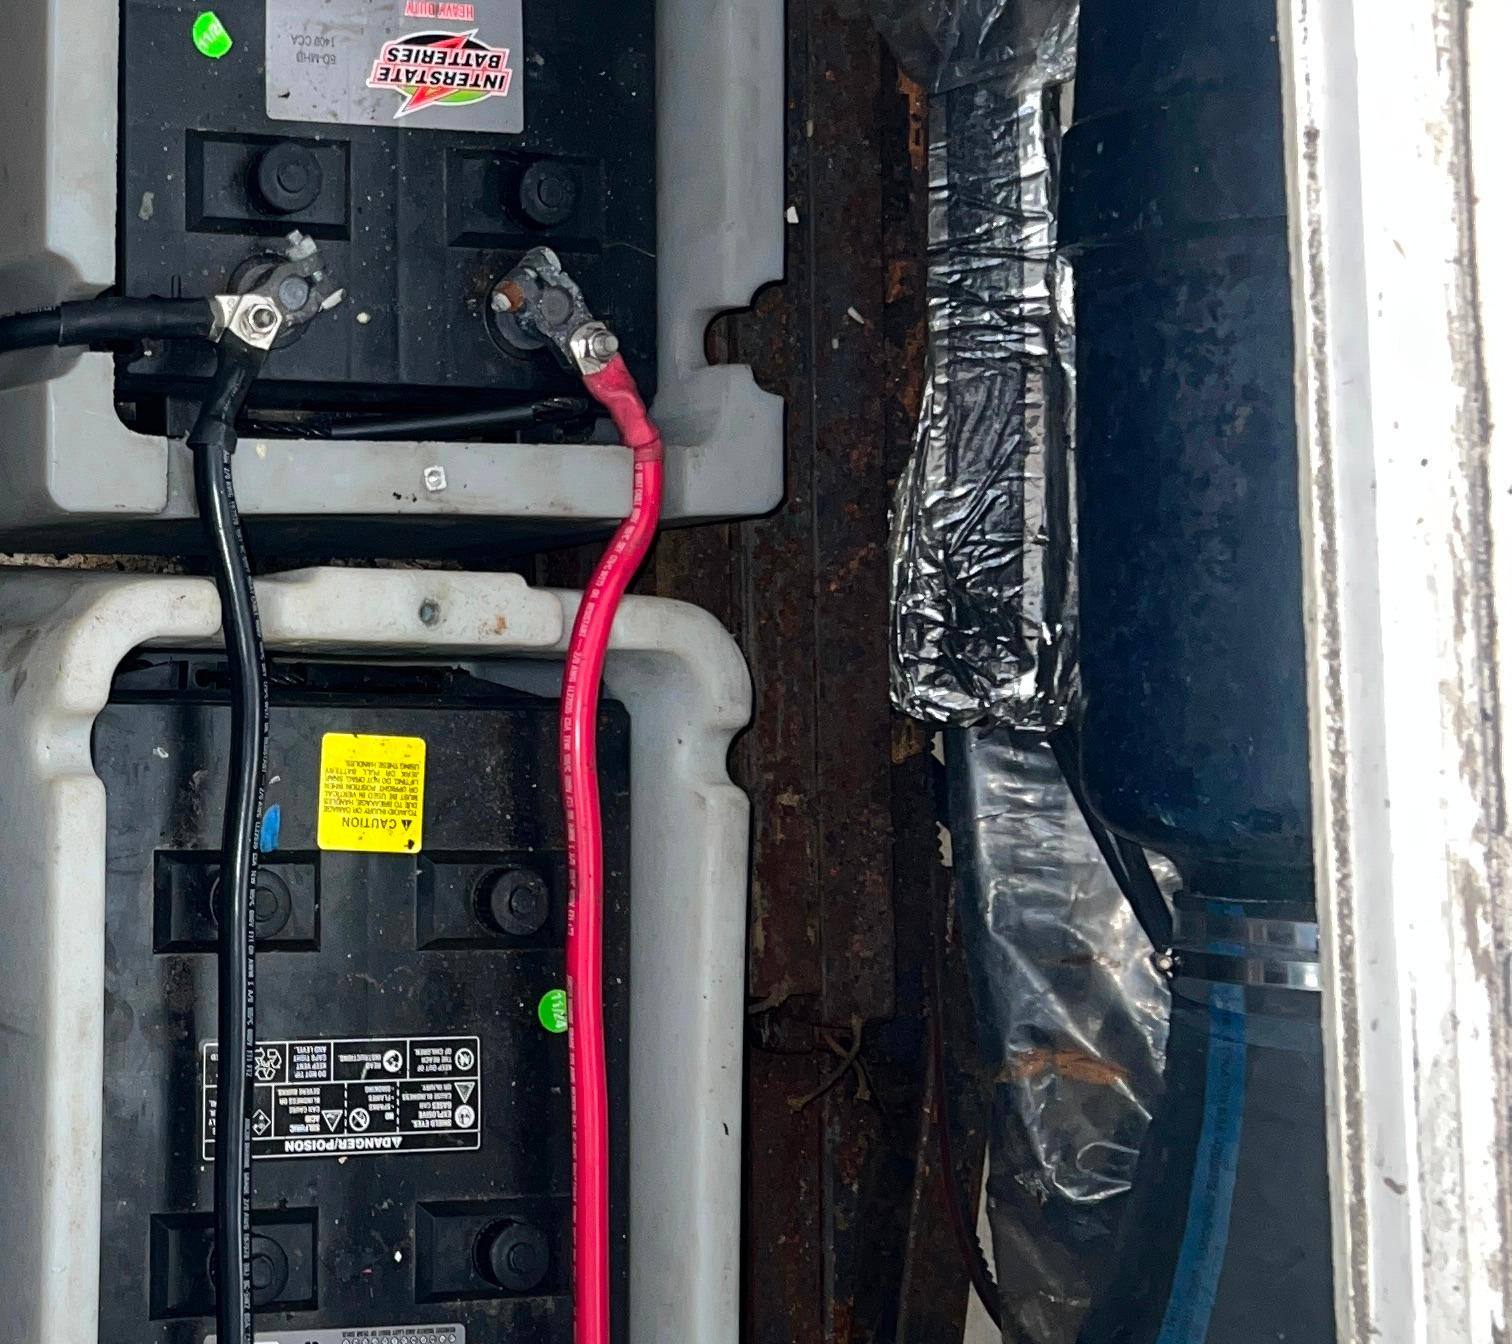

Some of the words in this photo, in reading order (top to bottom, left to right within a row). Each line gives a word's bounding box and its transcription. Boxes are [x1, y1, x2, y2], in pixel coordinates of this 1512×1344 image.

[405, 0, 435, 17] DUTY
[439, 2, 473, 20] HEAVY
[290, 34, 311, 46] CCA
[386, 47, 502, 69] BATTERIES
[377, 66, 506, 89] INTERSTATE
[342, 817, 397, 829] CAUTION
[284, 1136, 392, 1152] DANGER/POISON
